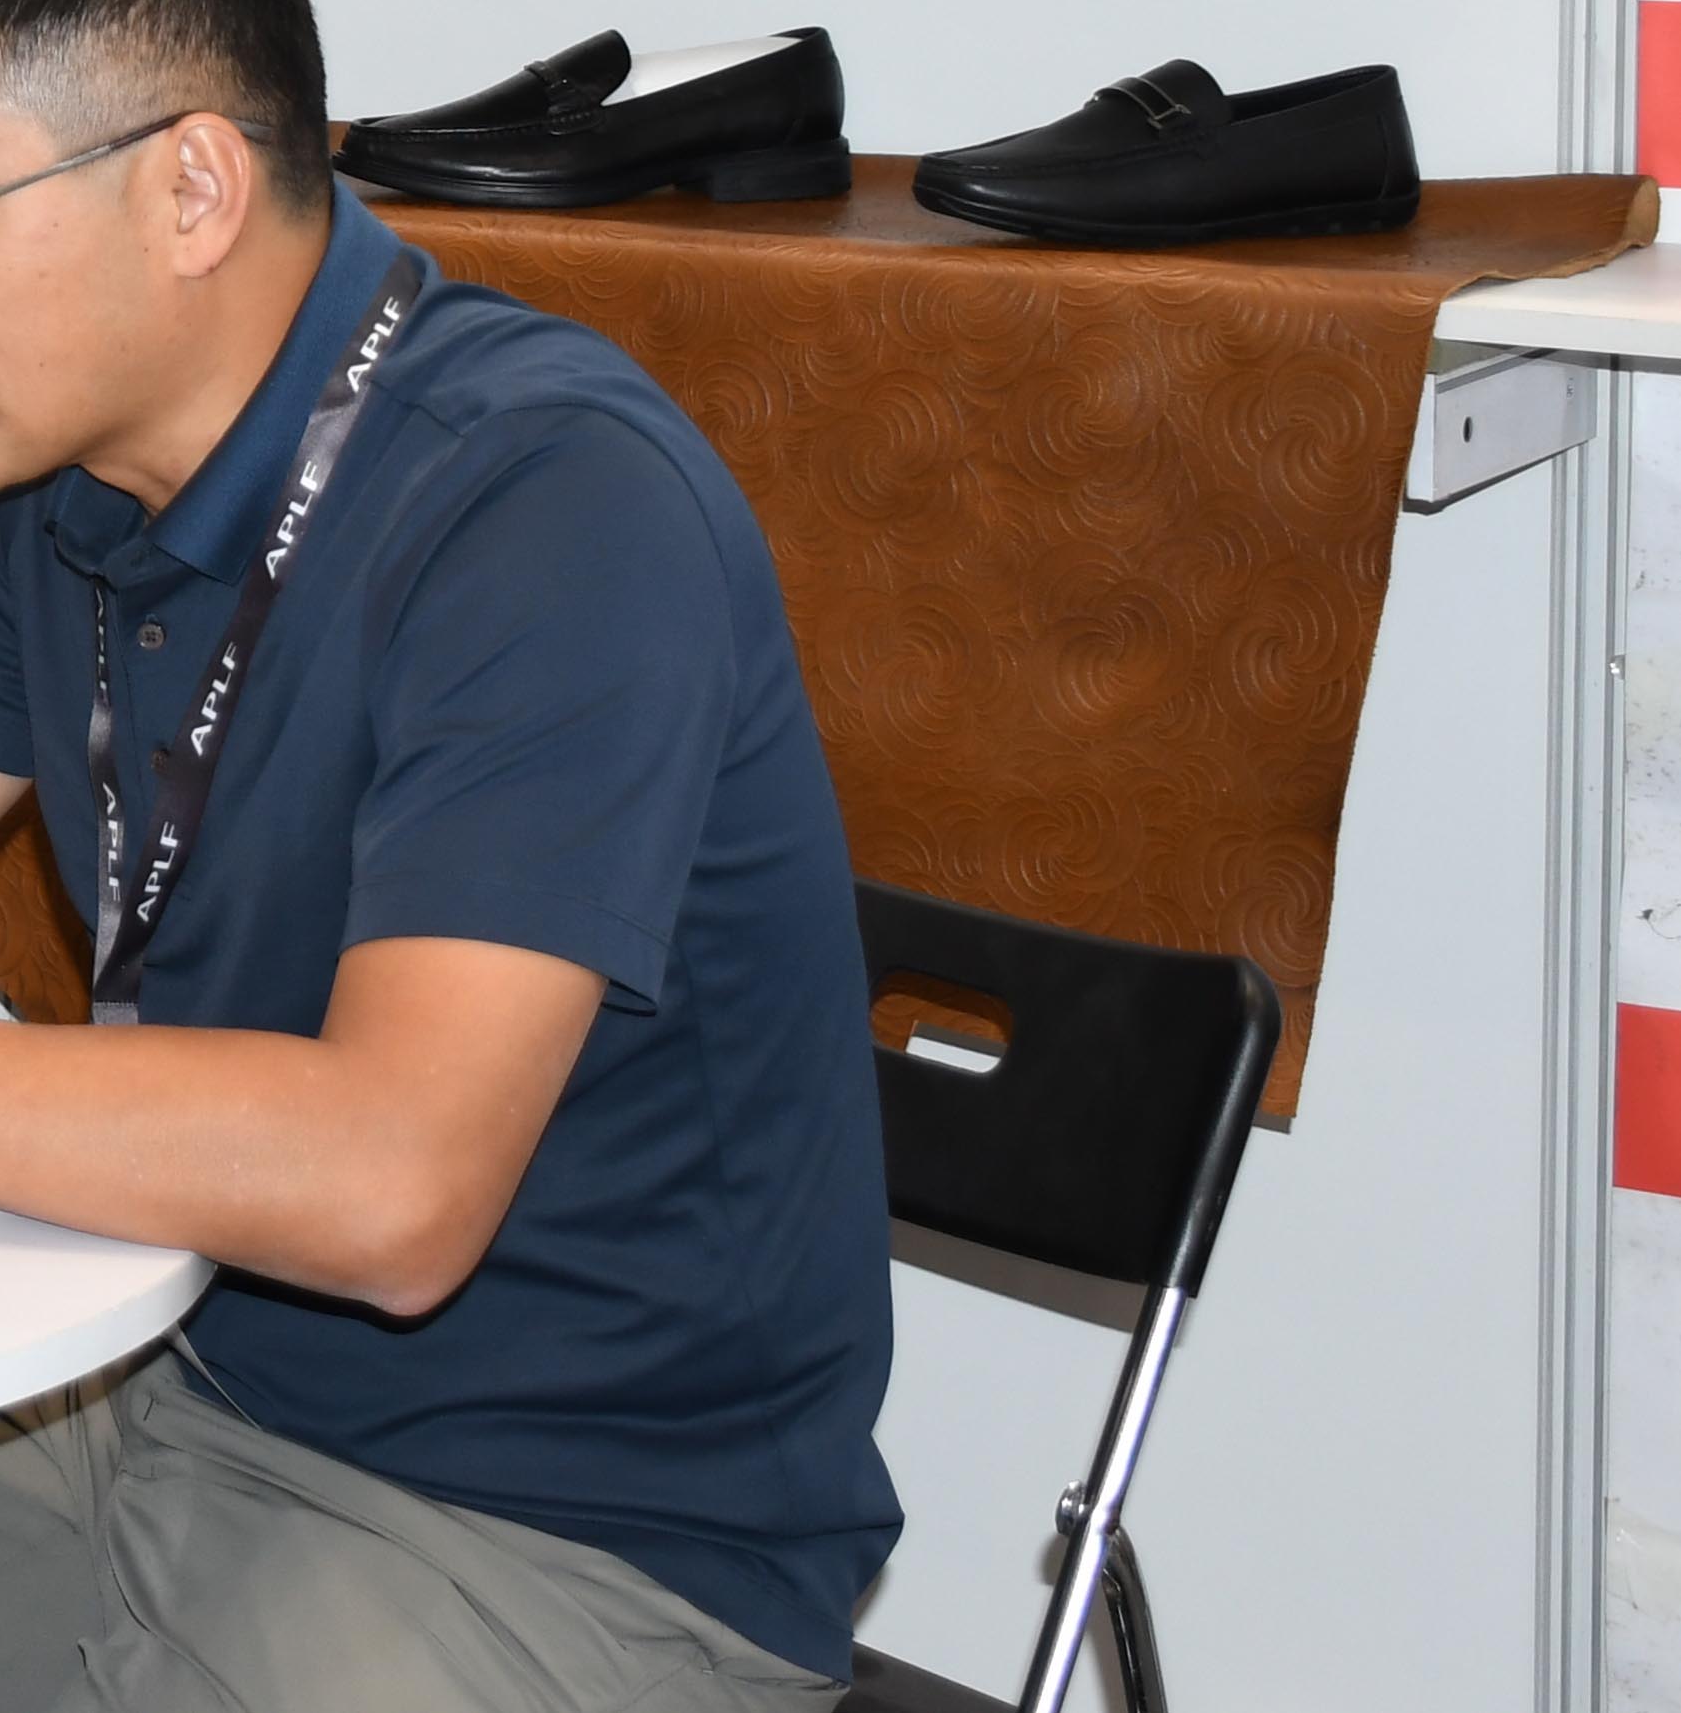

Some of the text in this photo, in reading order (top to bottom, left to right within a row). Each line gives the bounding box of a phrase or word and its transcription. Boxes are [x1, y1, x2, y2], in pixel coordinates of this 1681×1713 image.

[346, 296, 401, 393] APLF
[264, 461, 322, 580] APLF
[190, 640, 240, 756] APLF
[136, 821, 181, 924] APLF
